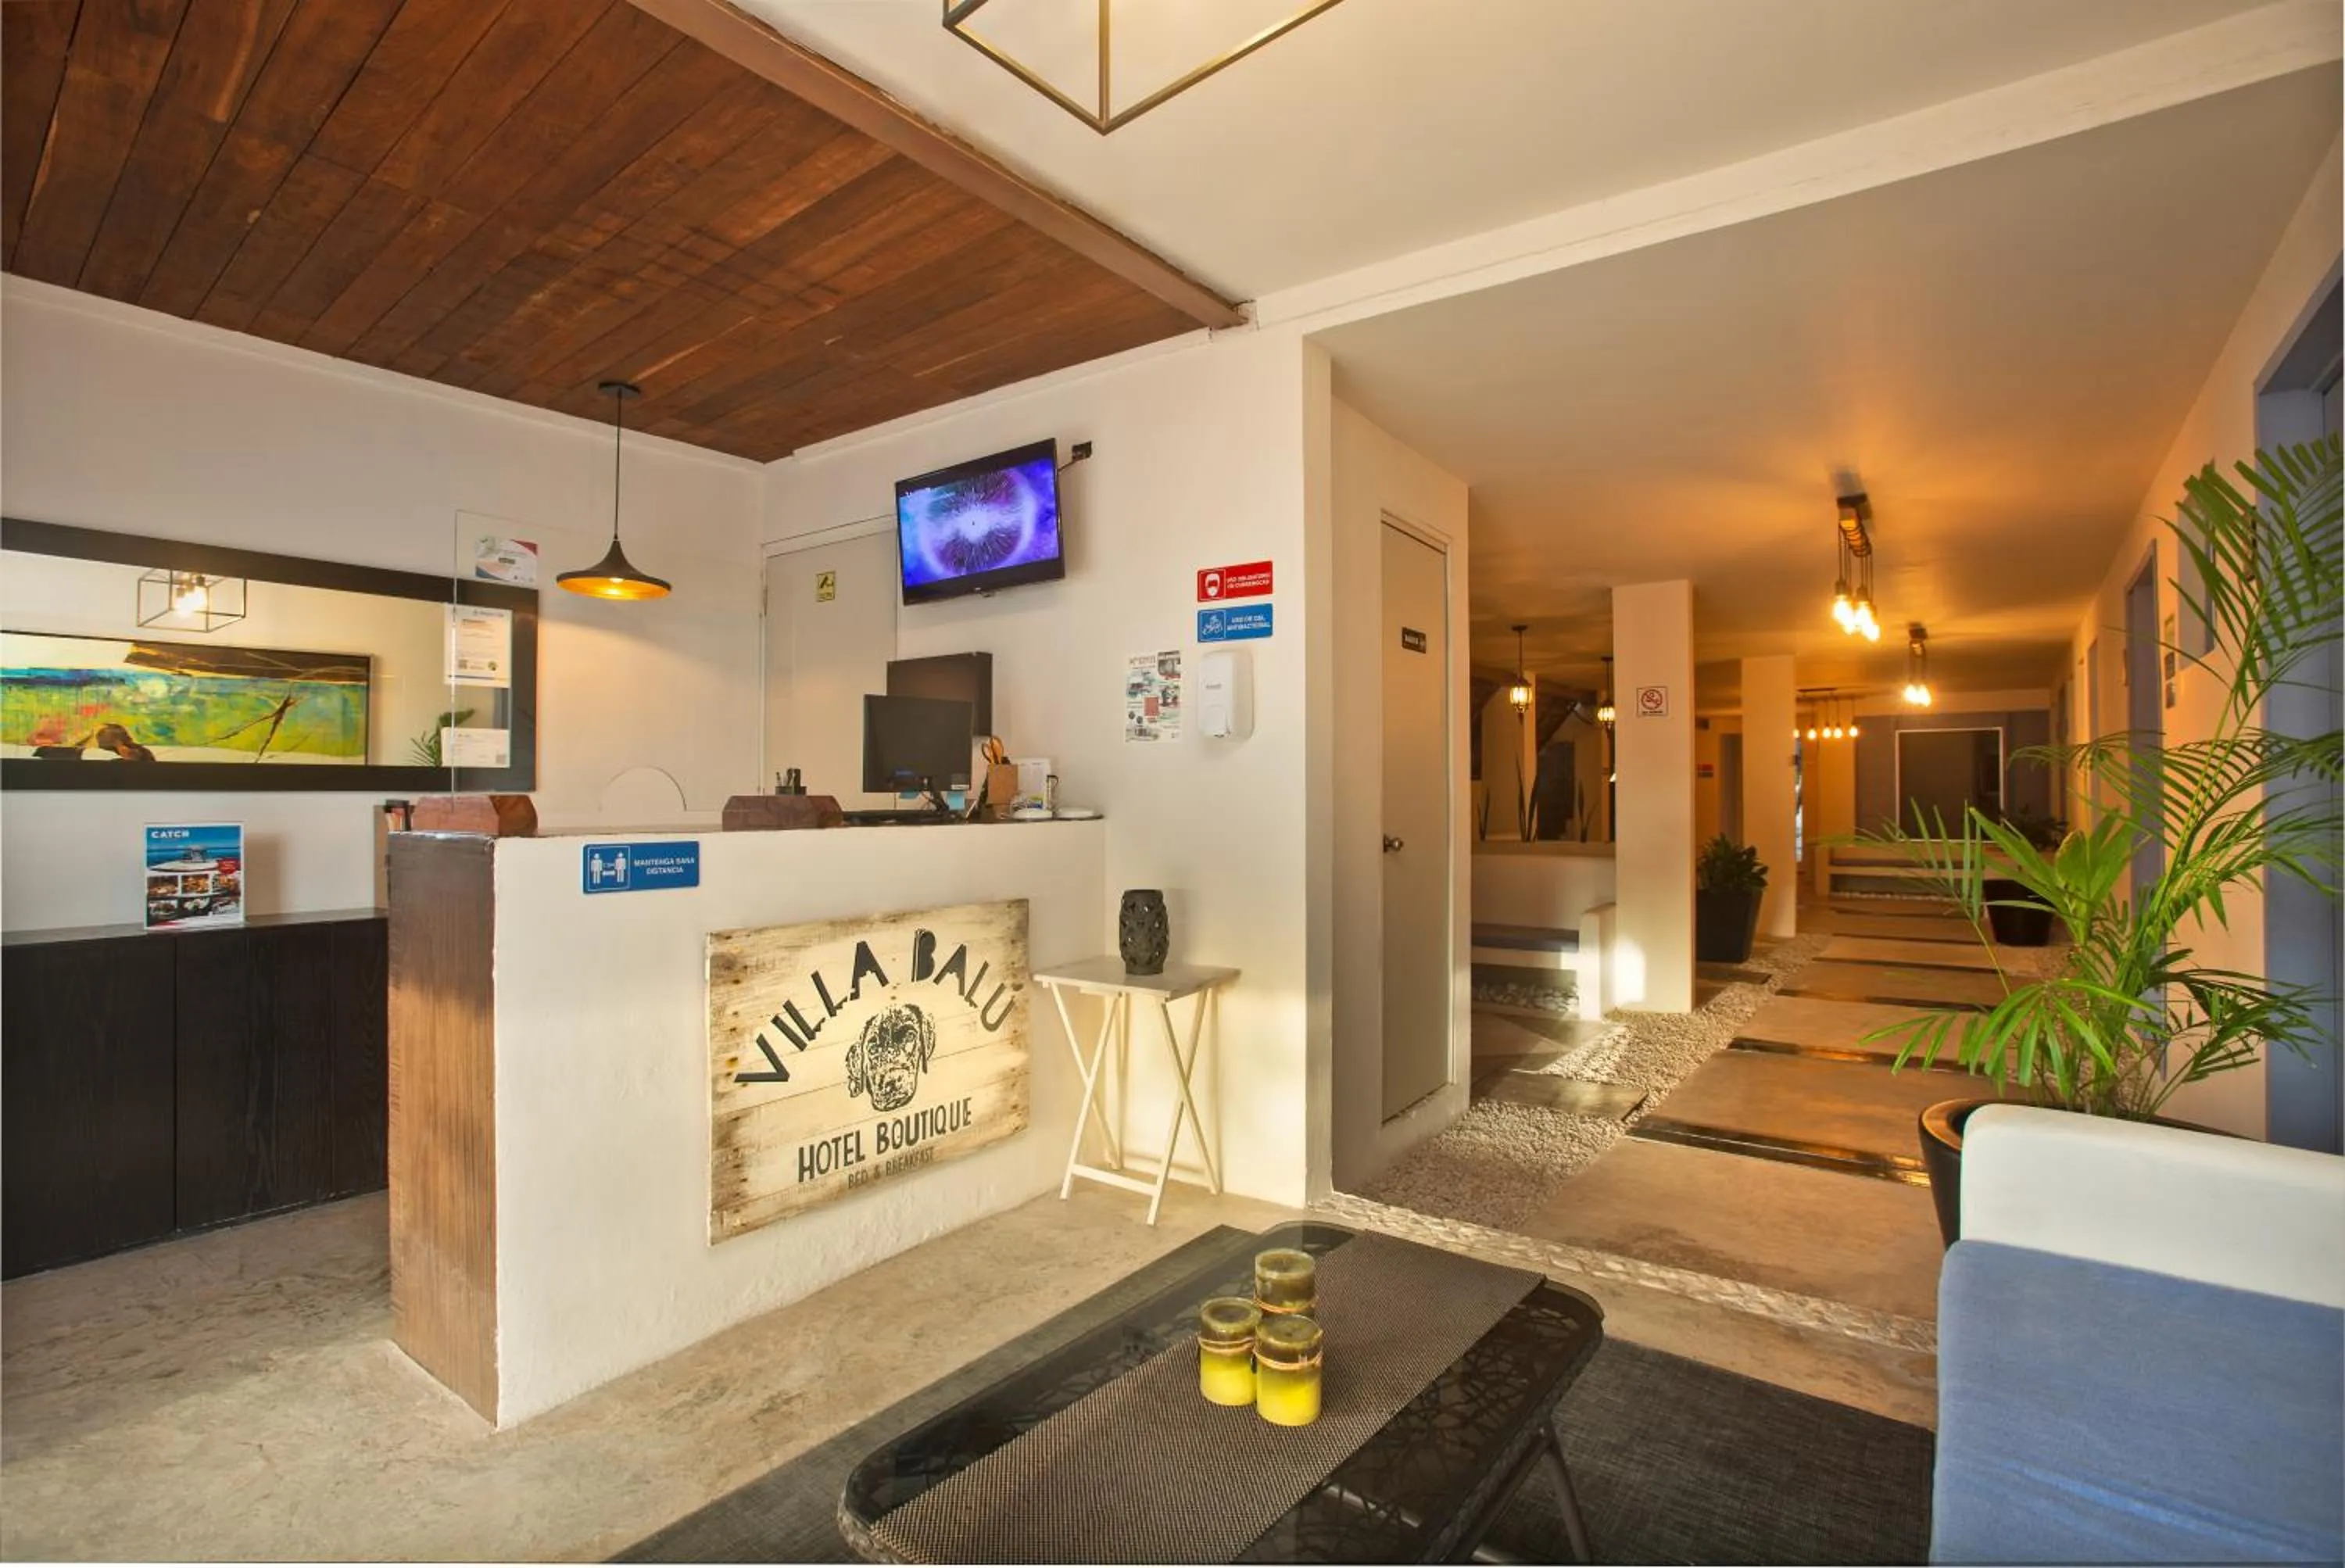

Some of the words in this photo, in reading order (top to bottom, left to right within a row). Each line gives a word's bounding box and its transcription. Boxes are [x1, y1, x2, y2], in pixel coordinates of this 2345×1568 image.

[634, 857, 674, 867] MANTENGA
[646, 866, 684, 875] DISTANCIA
[734, 940, 890, 1083] VILLA
[911, 928, 1017, 1032] BALU
[798, 1130, 865, 1183] HOTEL
[876, 1097, 972, 1155] BOUTIQUE
[848, 1169, 868, 1189] BED
[886, 1146, 934, 1176] BREAKFAST
